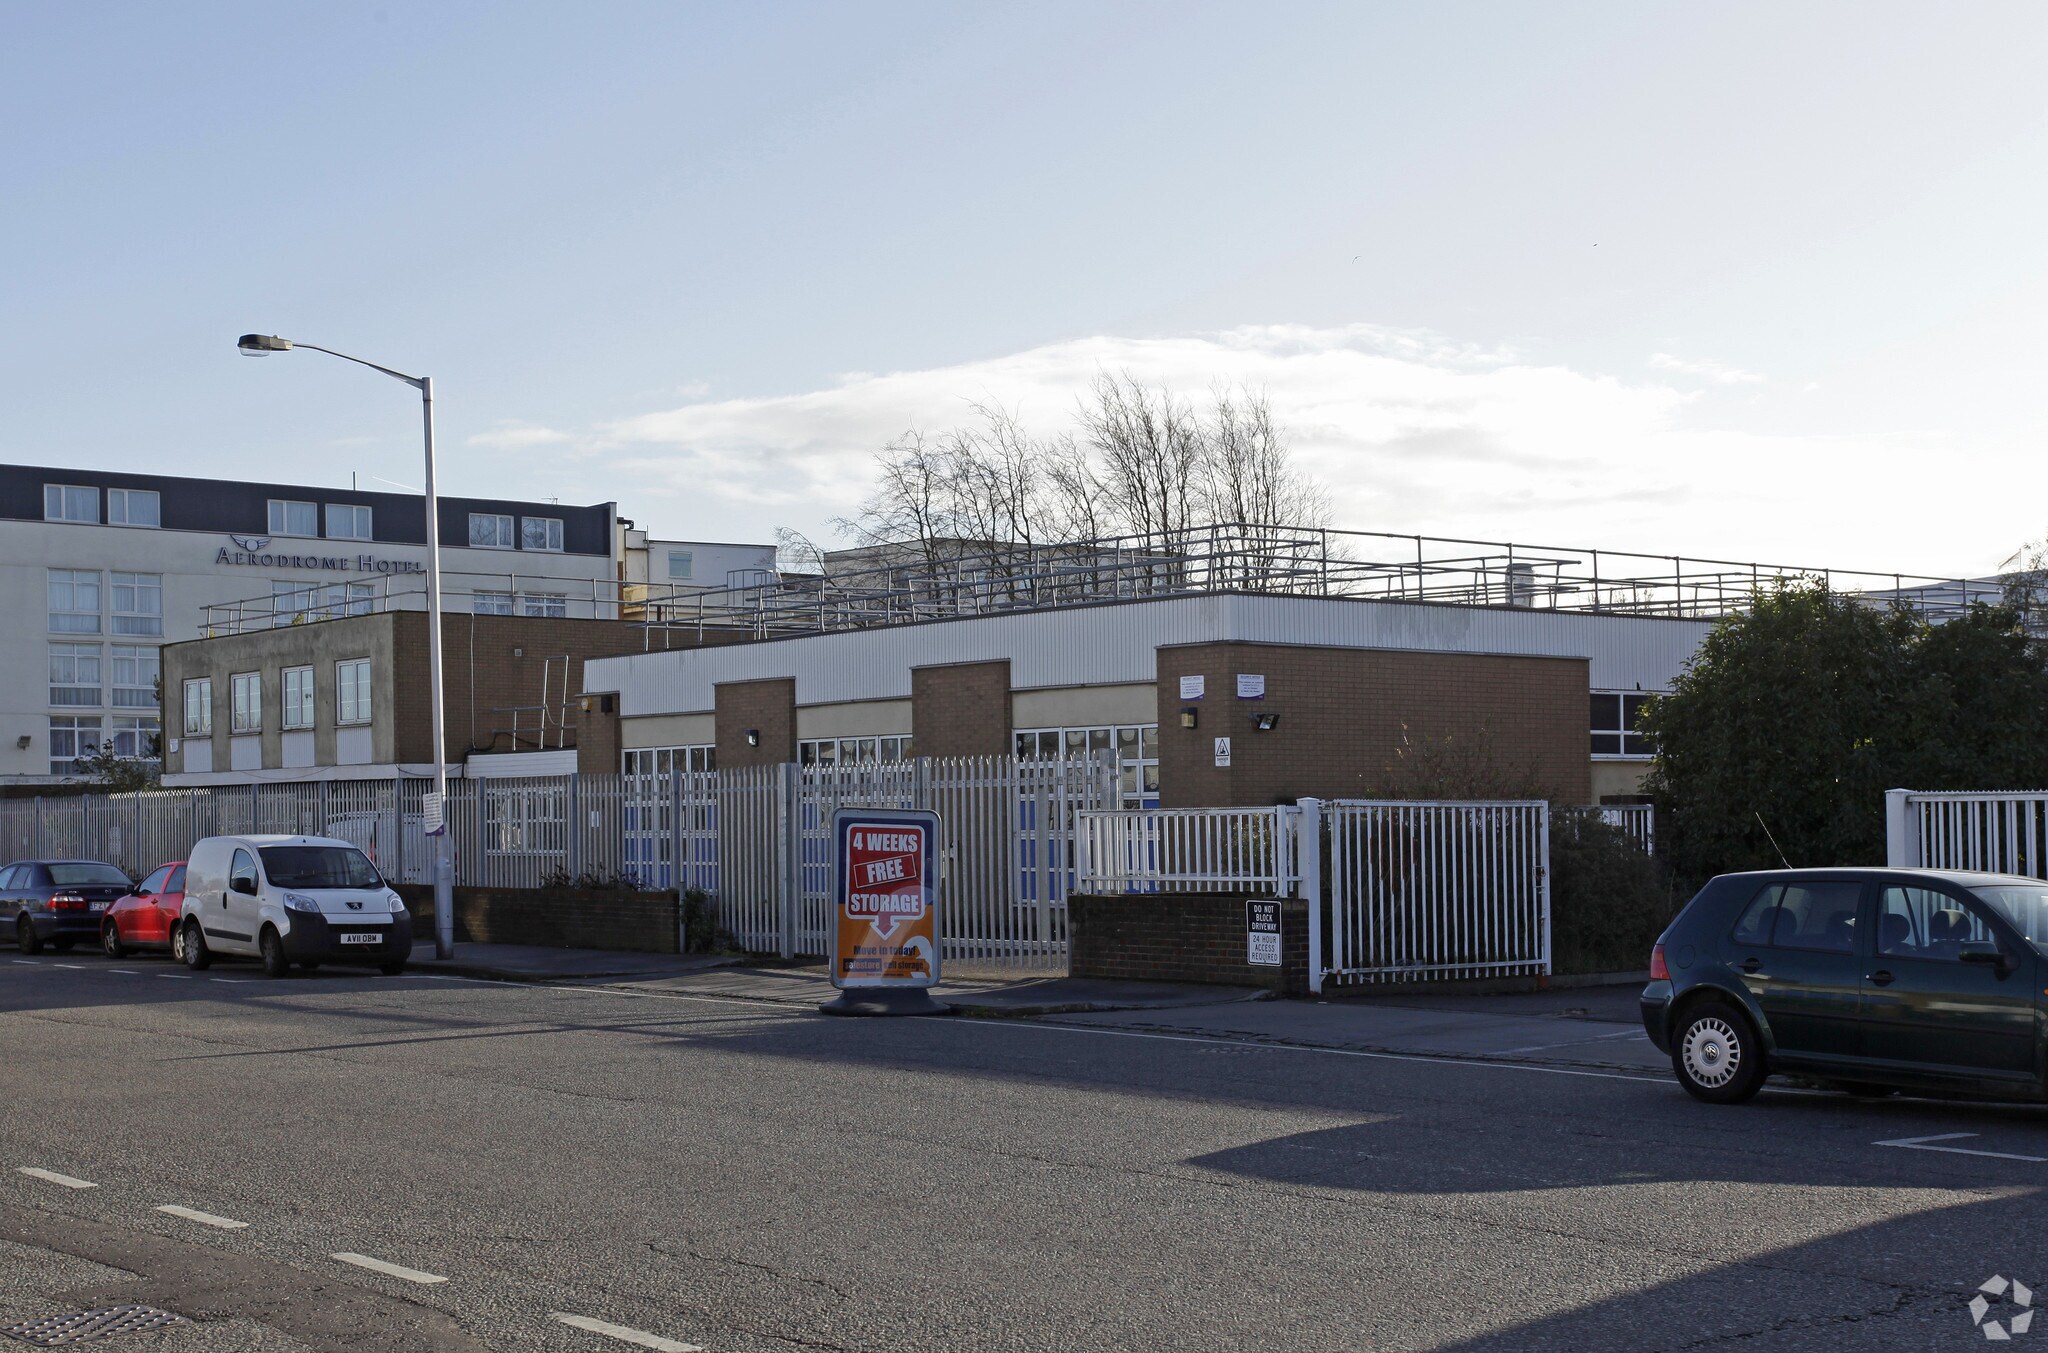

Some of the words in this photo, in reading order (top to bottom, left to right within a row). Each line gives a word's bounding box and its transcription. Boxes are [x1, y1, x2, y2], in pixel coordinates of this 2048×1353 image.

[853, 833, 863, 850] 4
[867, 833, 918, 852] WEEKS
[867, 858, 904, 883] FREE
[851, 894, 919, 913] STORAGE
[1254, 905, 1262, 913] DO
[1264, 905, 1274, 914] NOT
[1256, 914, 1273, 922] BLOCK
[1252, 922, 1277, 931] DRIVEWAY
[1253, 935, 1260, 943] 24
[1262, 936, 1277, 944] HOUR
[854, 945, 877, 955] Move
[1255, 944, 1275, 953] ACCESS
[1252, 953, 1278, 961] REQUIRED
